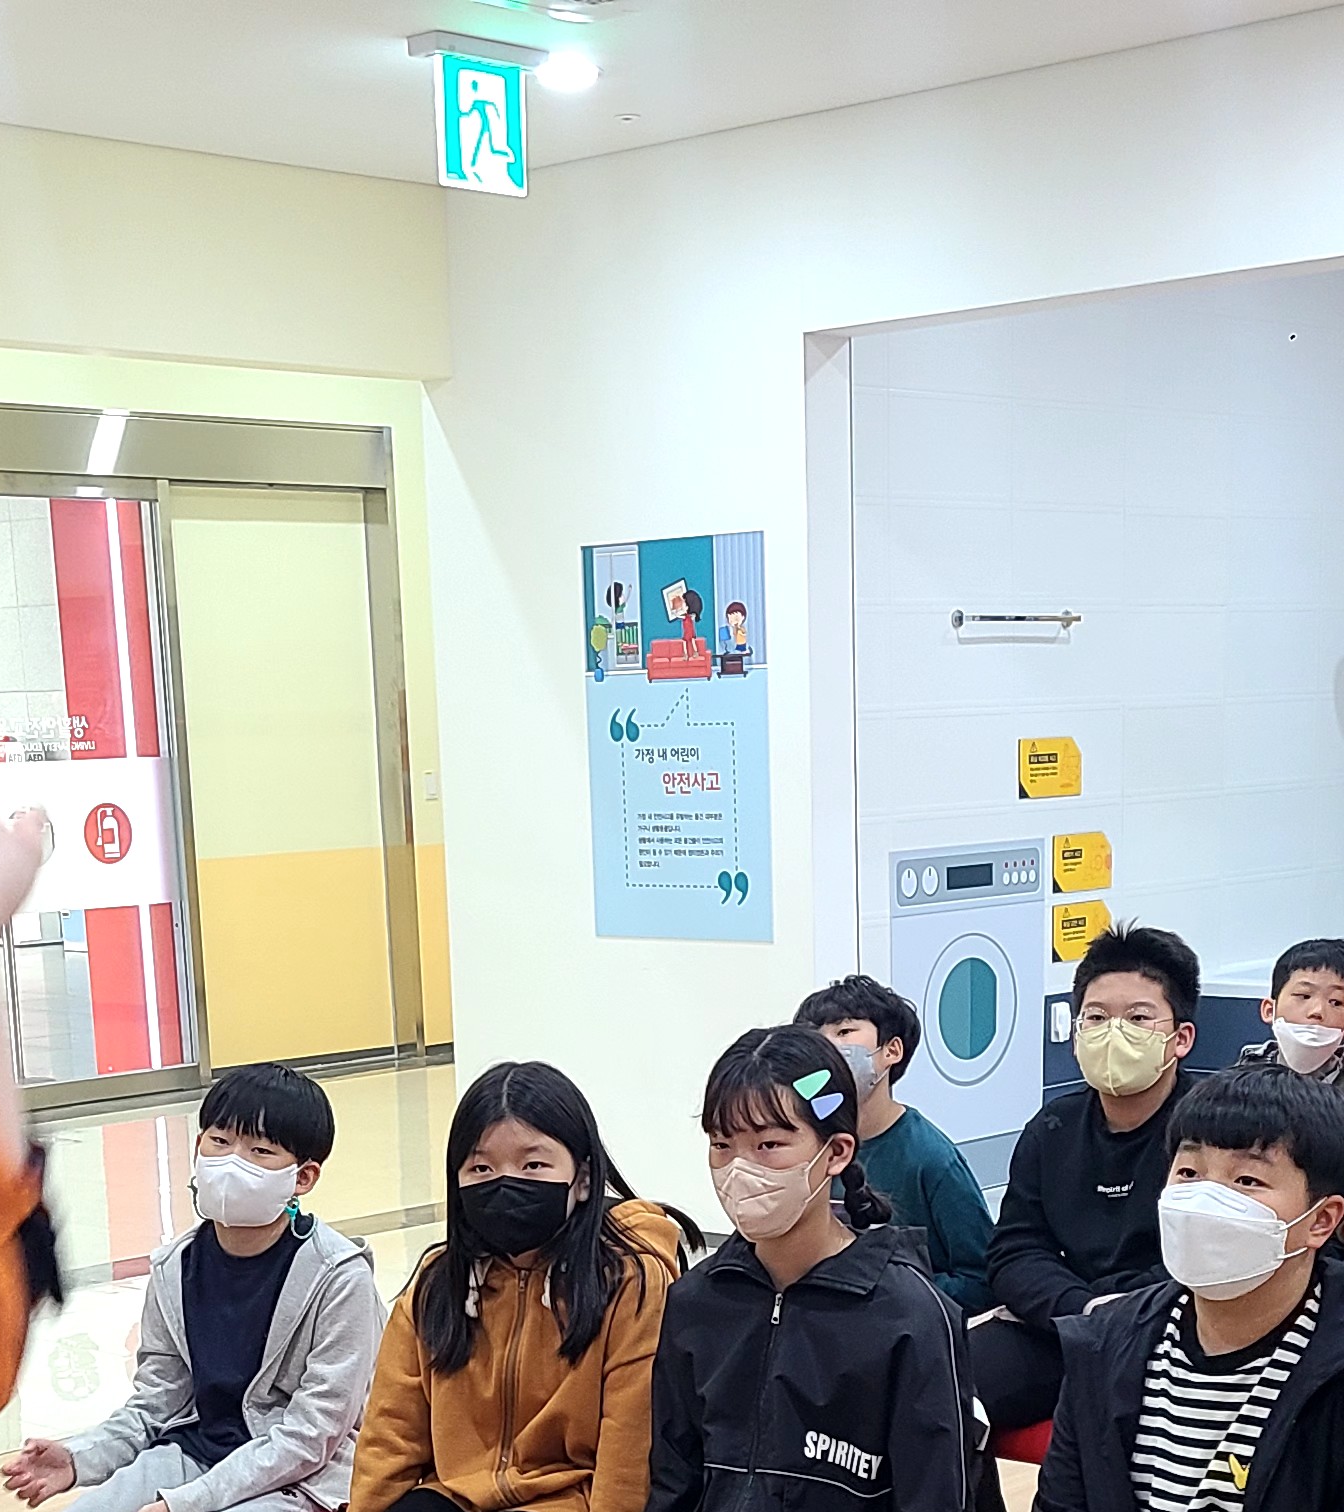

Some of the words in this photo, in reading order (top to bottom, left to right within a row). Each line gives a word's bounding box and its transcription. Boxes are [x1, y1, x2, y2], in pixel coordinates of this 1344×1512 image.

[635, 748, 655, 764] 가정
[658, 748, 667, 761] 내
[670, 747, 699, 763] 어린이
[662, 772, 721, 795] 안전사고
[804, 1430, 883, 1480] SPIRITEY
